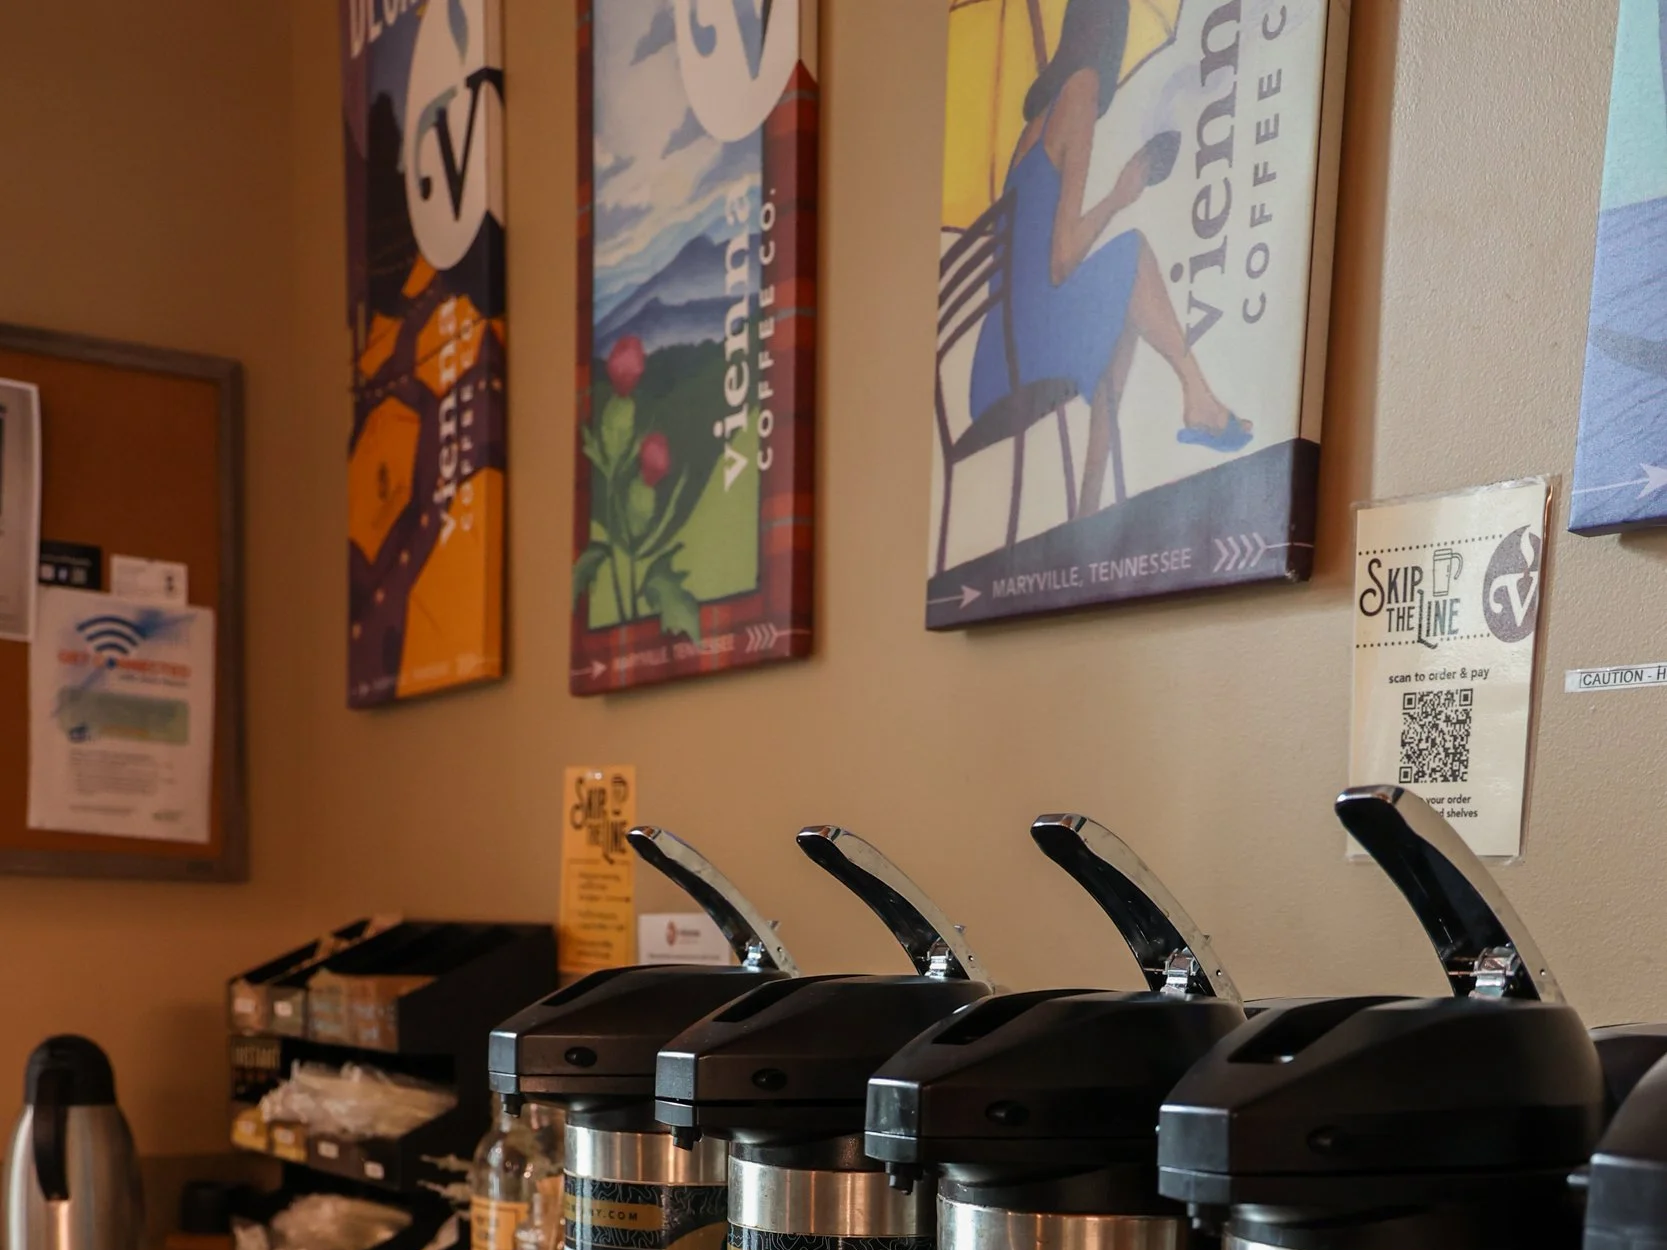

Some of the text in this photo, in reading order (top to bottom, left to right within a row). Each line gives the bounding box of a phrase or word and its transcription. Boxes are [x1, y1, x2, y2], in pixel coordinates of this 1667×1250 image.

[1170, 0, 1242, 357] vienn
[1242, 68, 1283, 324] COFFEE
[713, 180, 750, 493] vienna
[757, 284, 776, 472] COFFEE
[992, 547, 1192, 599] MARYVILLE, TENNESSEE
[1359, 557, 1424, 617] SKIP
[1386, 588, 1461, 650] THE LINE
[1388, 666, 1490, 684] scan to order & pay
[1583, 669, 1644, 686] CAUTION
[1446, 808, 1478, 818] shelves
[1447, 793, 1471, 804] order
